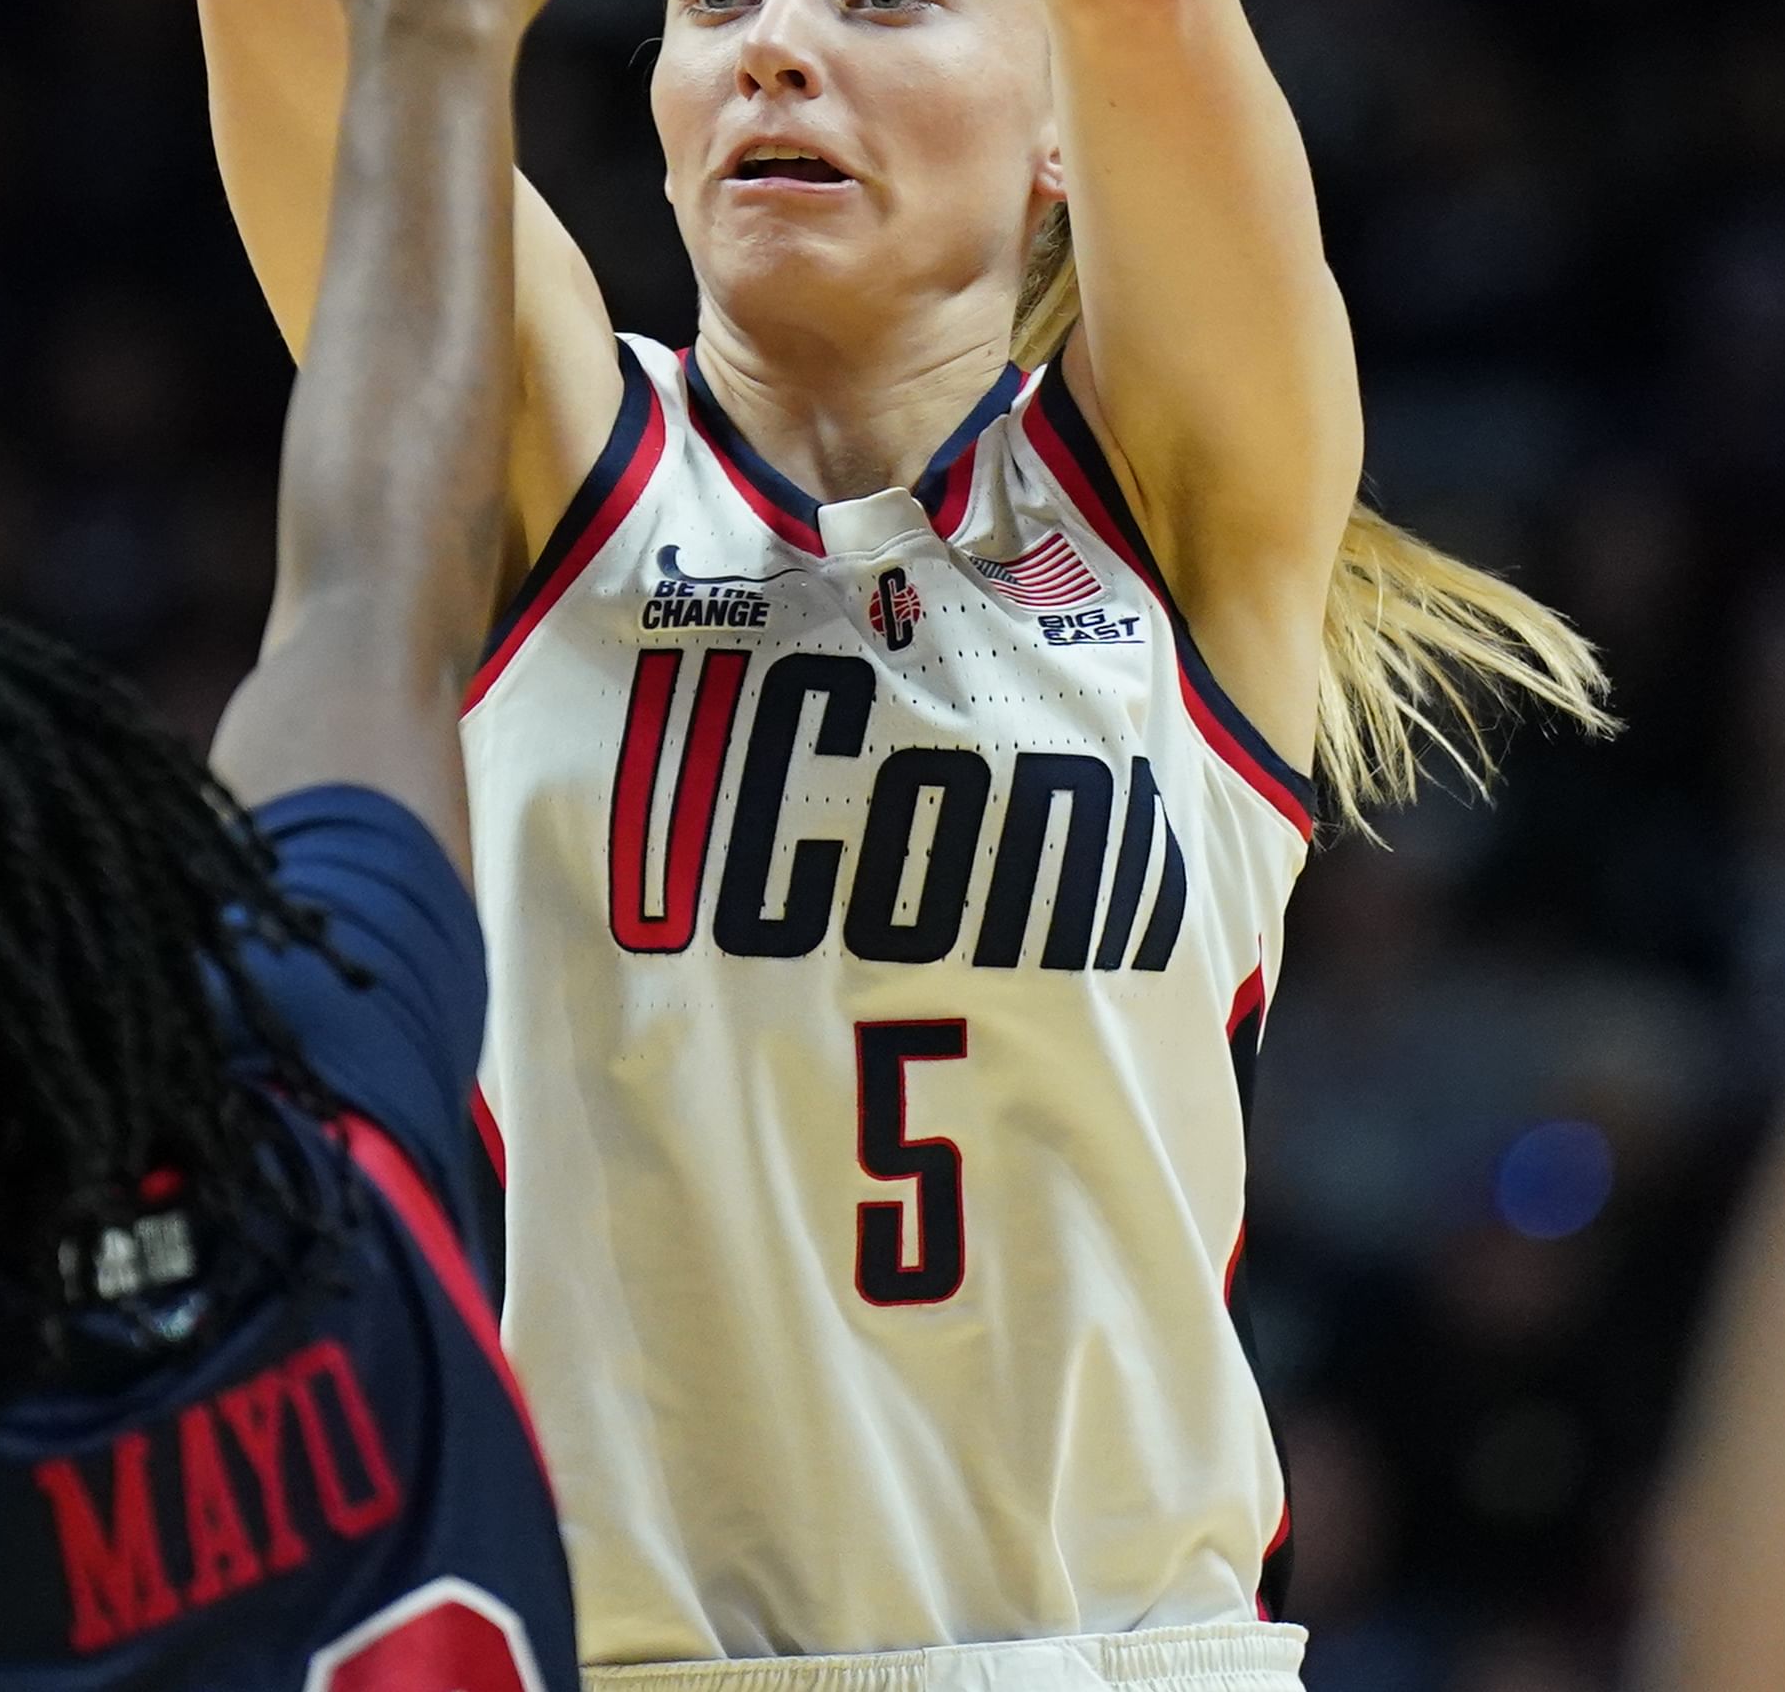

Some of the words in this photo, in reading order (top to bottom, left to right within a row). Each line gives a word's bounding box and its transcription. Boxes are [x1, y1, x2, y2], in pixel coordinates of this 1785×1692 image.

[654, 580, 696, 598] BE
[642, 599, 771, 629] CHANGE
[1038, 609, 1106, 628] BIG
[1043, 617, 1140, 641] EAST
[855, 1018, 967, 1307] 5
[34, 1339, 401, 1653] MAYO
